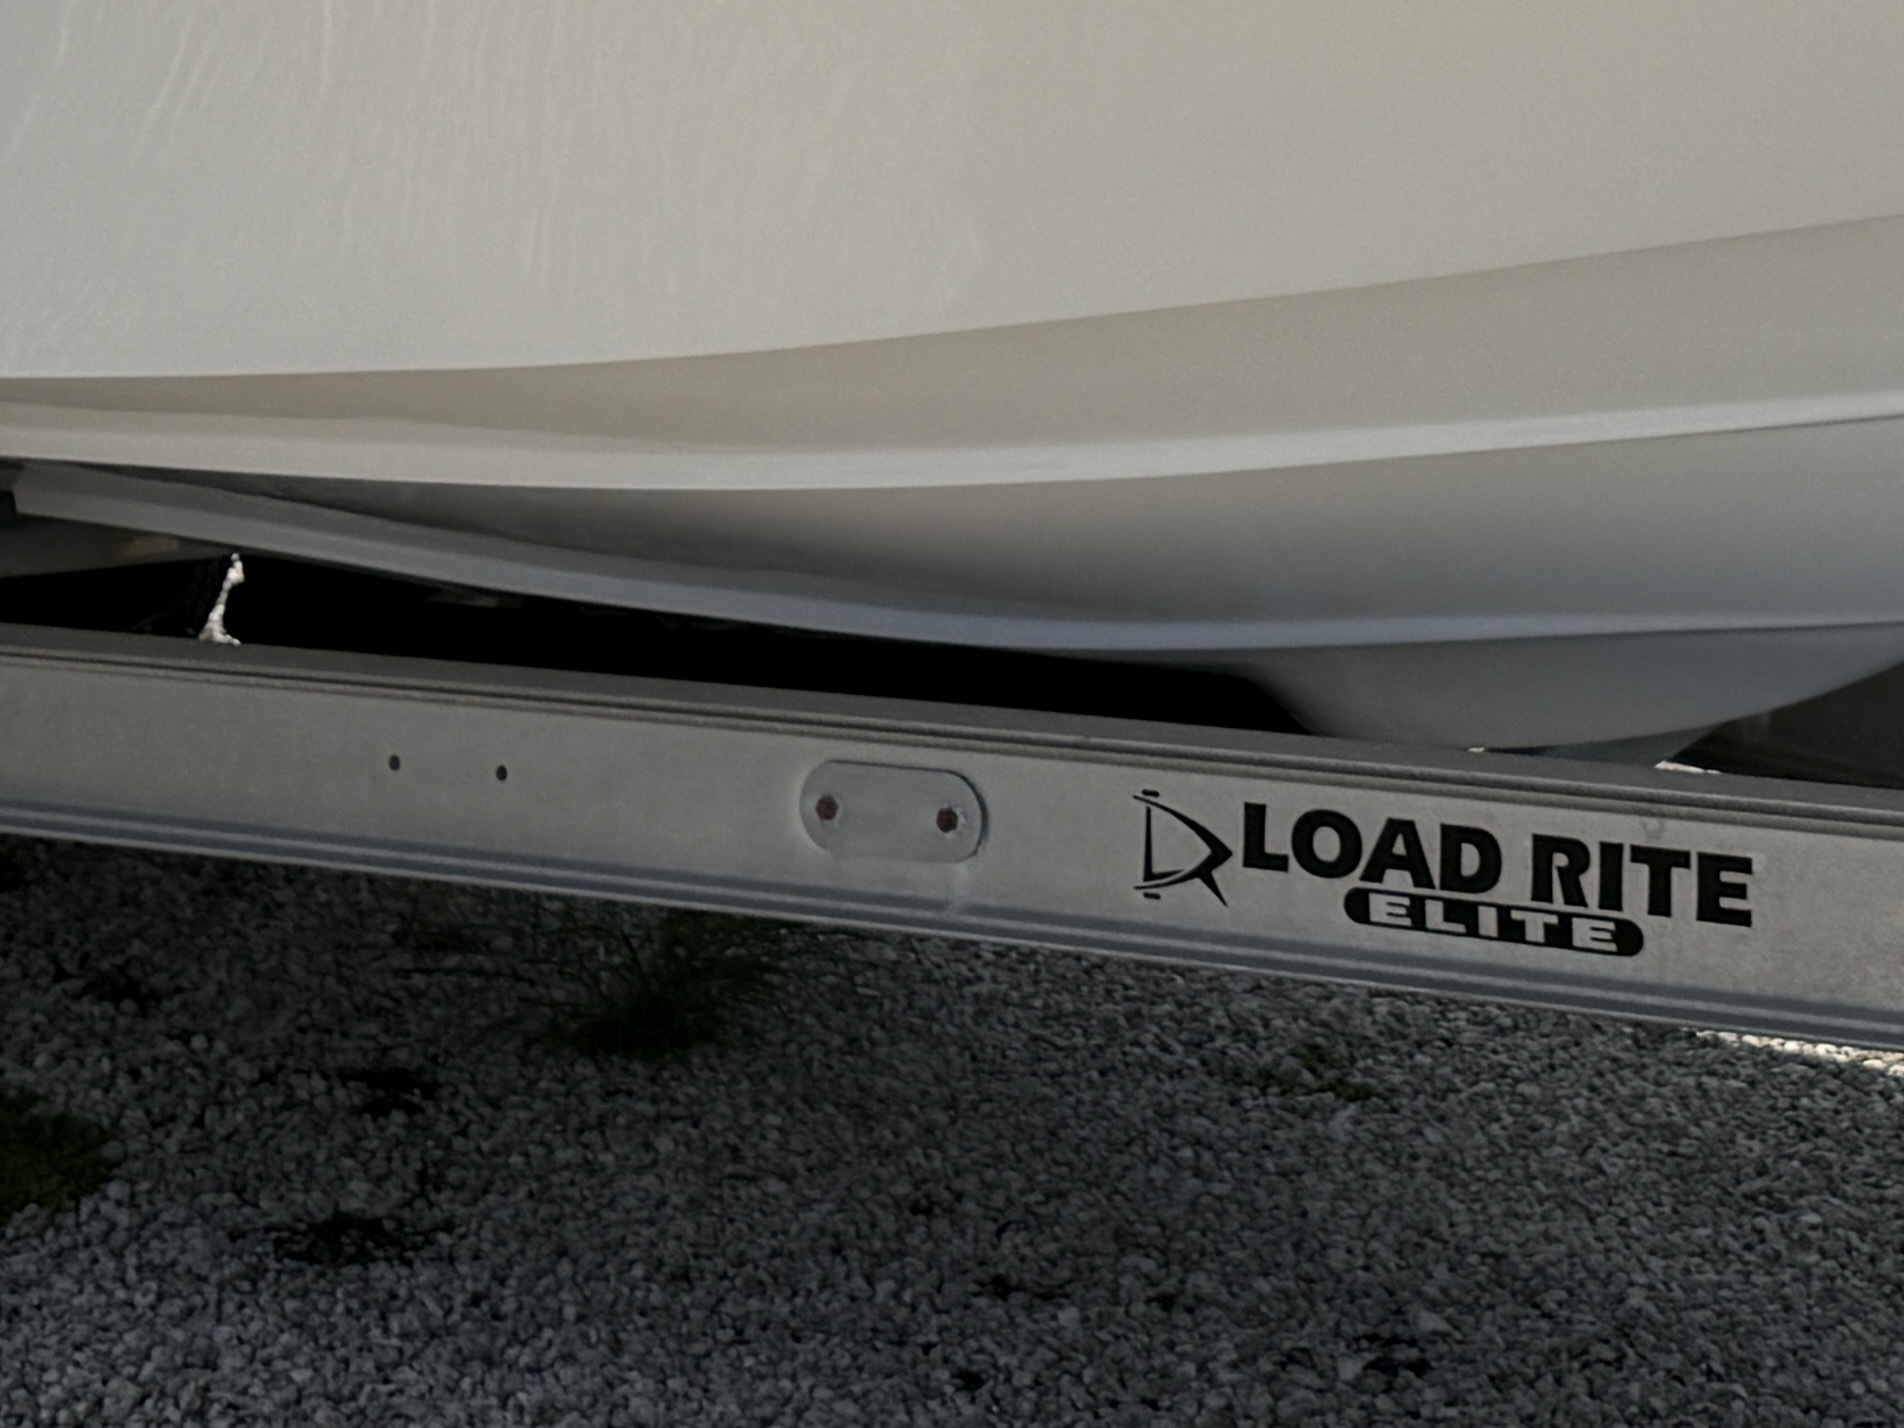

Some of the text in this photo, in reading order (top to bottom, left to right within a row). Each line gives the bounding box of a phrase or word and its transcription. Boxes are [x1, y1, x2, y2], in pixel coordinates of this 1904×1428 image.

[1242, 801, 1753, 928] LOAD RITE
[1368, 894, 1620, 953] ELITE
